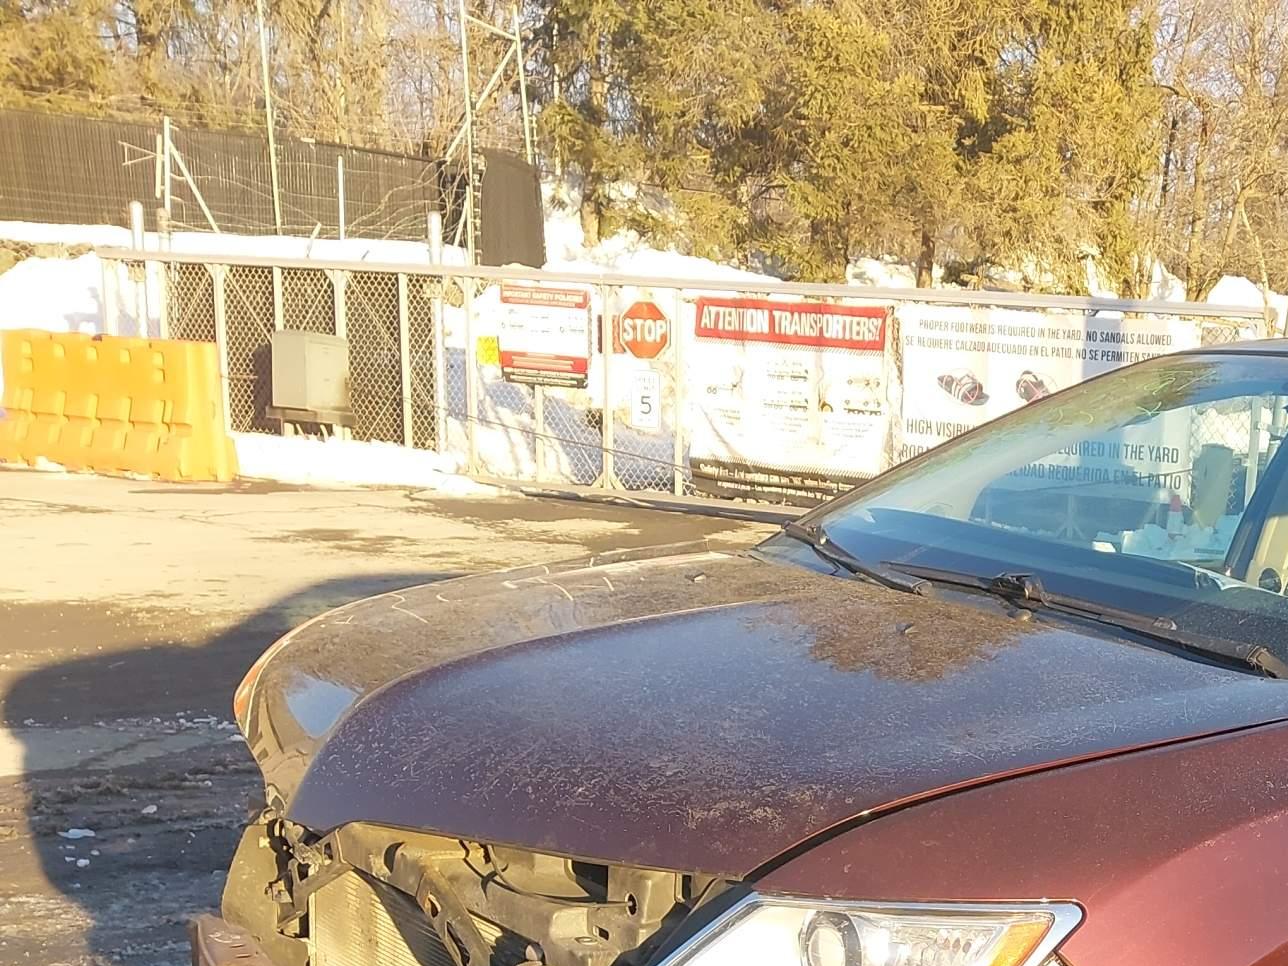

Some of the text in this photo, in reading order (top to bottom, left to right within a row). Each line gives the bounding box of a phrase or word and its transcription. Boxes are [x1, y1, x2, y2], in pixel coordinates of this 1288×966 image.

[623, 318, 667, 342] STOP
[700, 305, 883, 342] ATTENTION TRANSPORTERS!
[919, 319, 949, 332] PROPER
[950, 321, 987, 335] FOOTWEAR
[988, 323, 995, 335] IS
[997, 325, 1036, 338] REQUIRED
[1038, 328, 1046, 338] IN
[1047, 328, 1060, 340] THE
[1086, 330, 1098, 342] NO
[1100, 331, 1135, 345] SANDALS
[1136, 334, 1172, 346] ALLOWED
[905, 335, 914, 346] SE
[917, 336, 953, 350] REQUIERE
[955, 339, 986, 352] CALZADO
[986, 342, 1027, 356] ADECUADO
[1029, 345, 1039, 356] EN
[1040, 346, 1049, 357] EL
[1075, 348, 1087, 360] NO
[1088, 349, 1099, 361] SE
[1101, 350, 1139, 362] PERMITEN
[640, 396, 652, 415] 5
[906, 418, 932, 436] HIGH
[1108, 443, 1120, 459] IN
[1124, 443, 1145, 461] THE
[1148, 445, 1179, 464] YARD
[1048, 463, 1110, 482] REQUERIDA
[1113, 469, 1129, 484] EN
[1132, 471, 1145, 487] EL
[1147, 472, 1182, 490] PATIO
